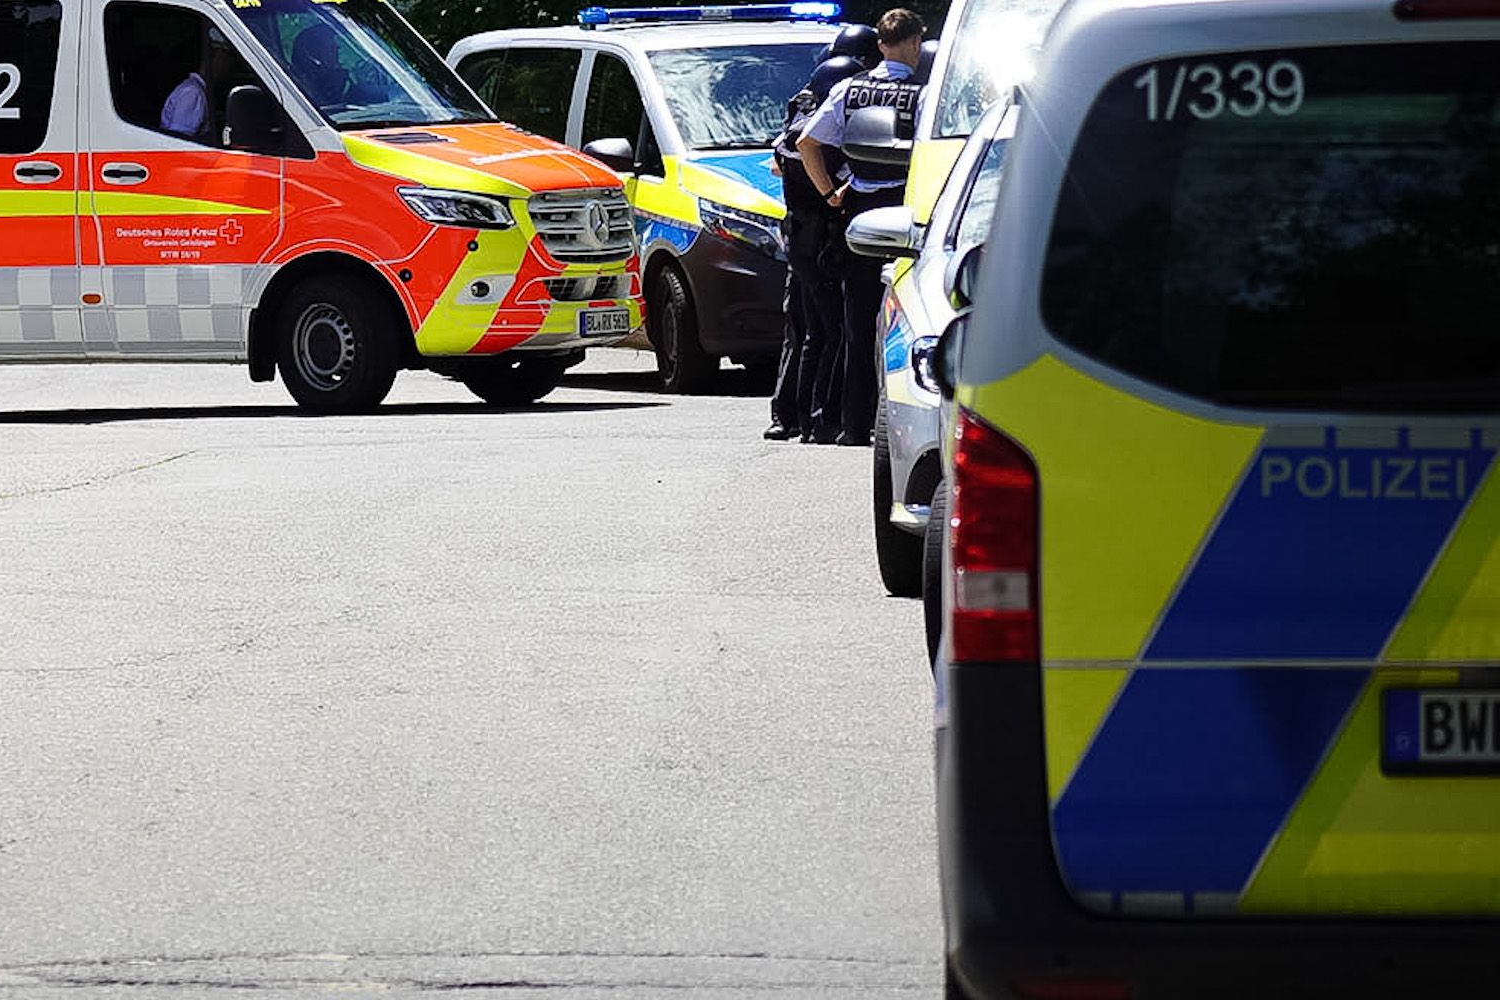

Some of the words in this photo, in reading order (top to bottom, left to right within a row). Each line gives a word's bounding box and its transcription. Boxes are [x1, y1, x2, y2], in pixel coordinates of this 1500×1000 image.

[846, 87, 914, 111] POLIZEI
[1133, 60, 1305, 122] 1/339
[191, 227, 218, 237] Kreuz
[1260, 456, 1467, 499] POLIZEI
[1424, 701, 1500, 754] BW
